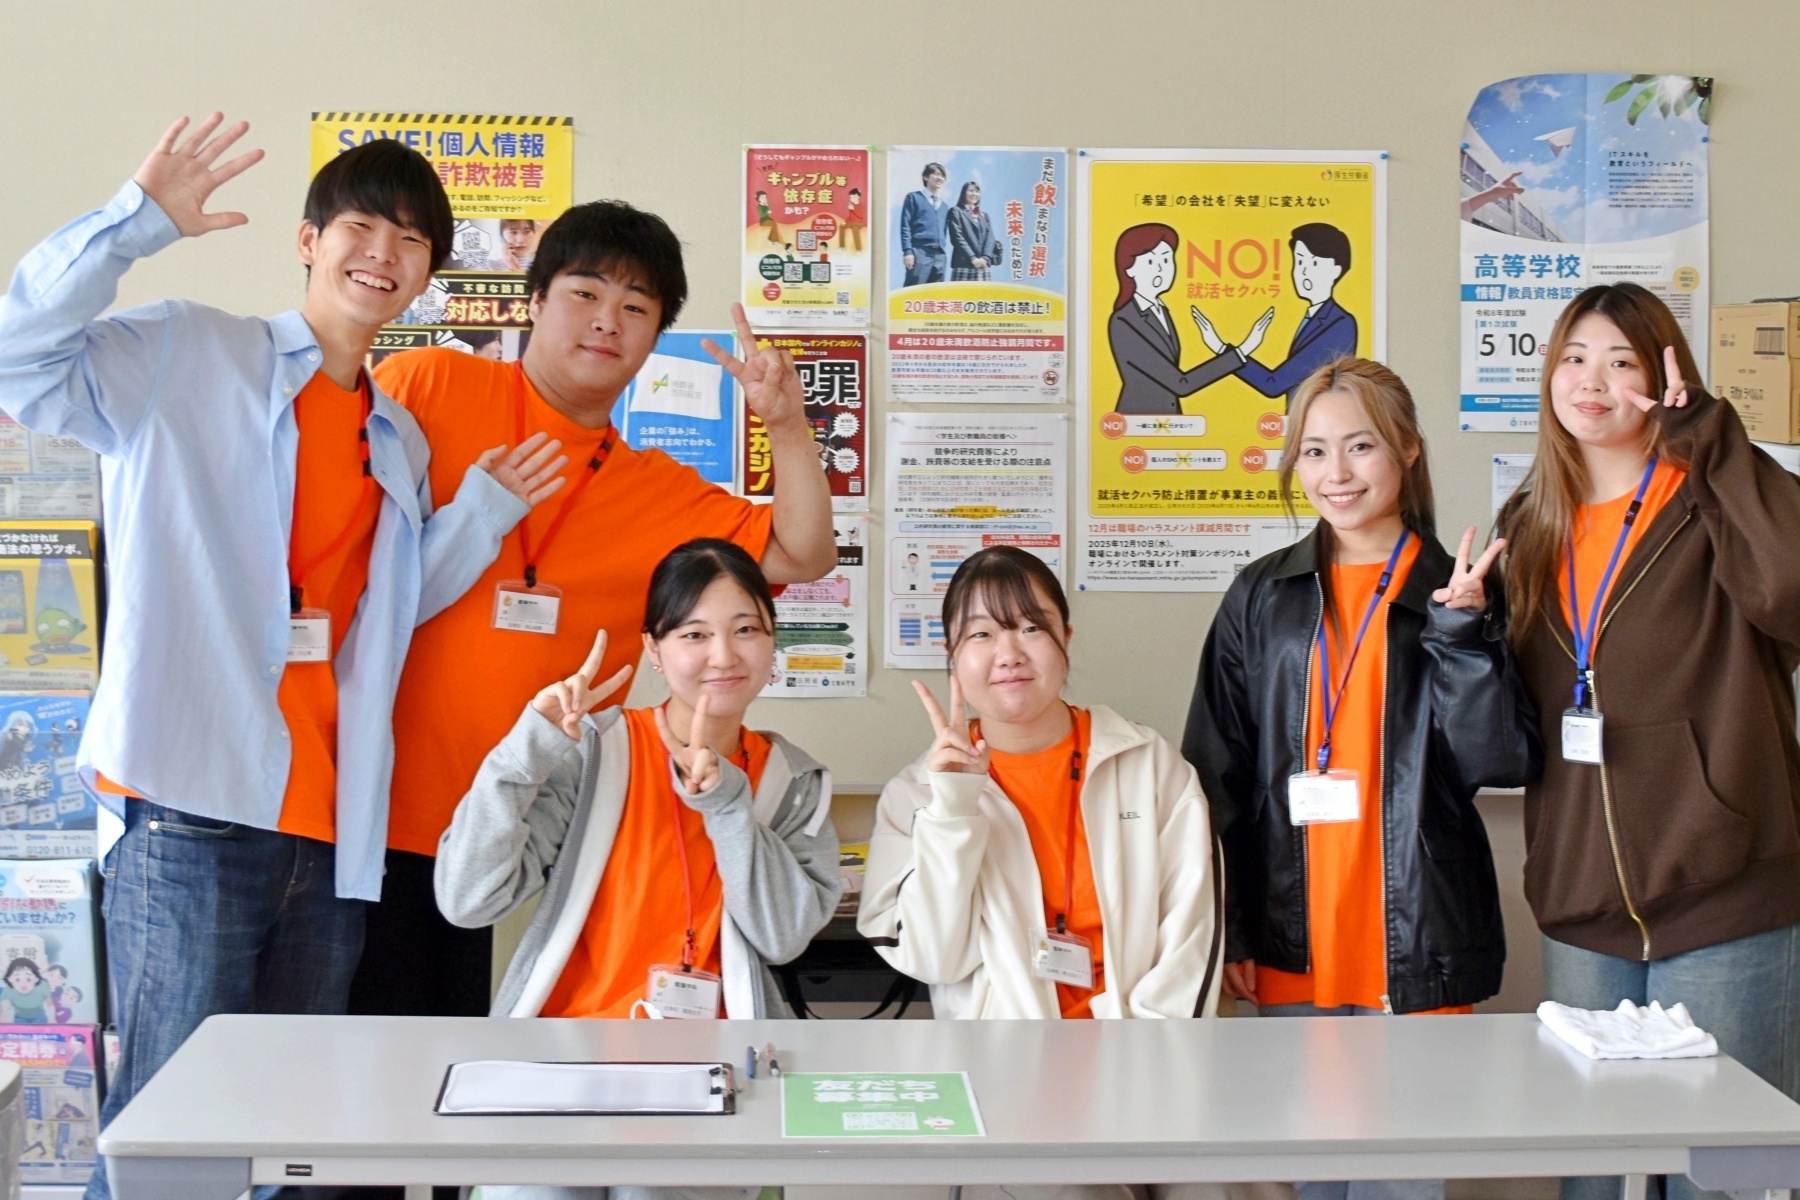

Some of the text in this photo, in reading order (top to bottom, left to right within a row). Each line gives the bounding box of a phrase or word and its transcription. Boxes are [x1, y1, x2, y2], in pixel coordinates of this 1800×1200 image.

[427, 160, 544, 189] 詐欺被害
[767, 171, 847, 187] ギャンブル等
[783, 188, 833, 204] 依存症
[1133, 194, 1331, 208] 「希望」の会社を「失望」に変えない
[1029, 157, 1058, 279] まだ飲まない選択
[1005, 200, 1025, 280] 未来のために
[1187, 239, 1281, 281] NO!
[1474, 253, 1581, 279] 高等学校
[463, 283, 525, 294] 不審な訪問
[1186, 283, 1281, 300] 就活セクハラ
[1475, 286, 1503, 300] 情報
[904, 300, 1050, 315] 20歳未満の飲酒は禁止!
[1476, 308, 1527, 318] 令和8年度試験
[1479, 320, 1518, 329] 第1次試験
[639, 426, 701, 436] 企業の「強み」は、
[1103, 421, 1124, 431] NO!
[1260, 421, 1281, 431] NO!
[639, 437, 717, 447] 消費者志向でわかる。
[1123, 455, 1145, 465] NO!
[1243, 455, 1264, 465] NO!
[1088, 540, 1174, 548] 2025年12月10日(水)、
[1088, 559, 1185, 568] オンラインで開催します。
